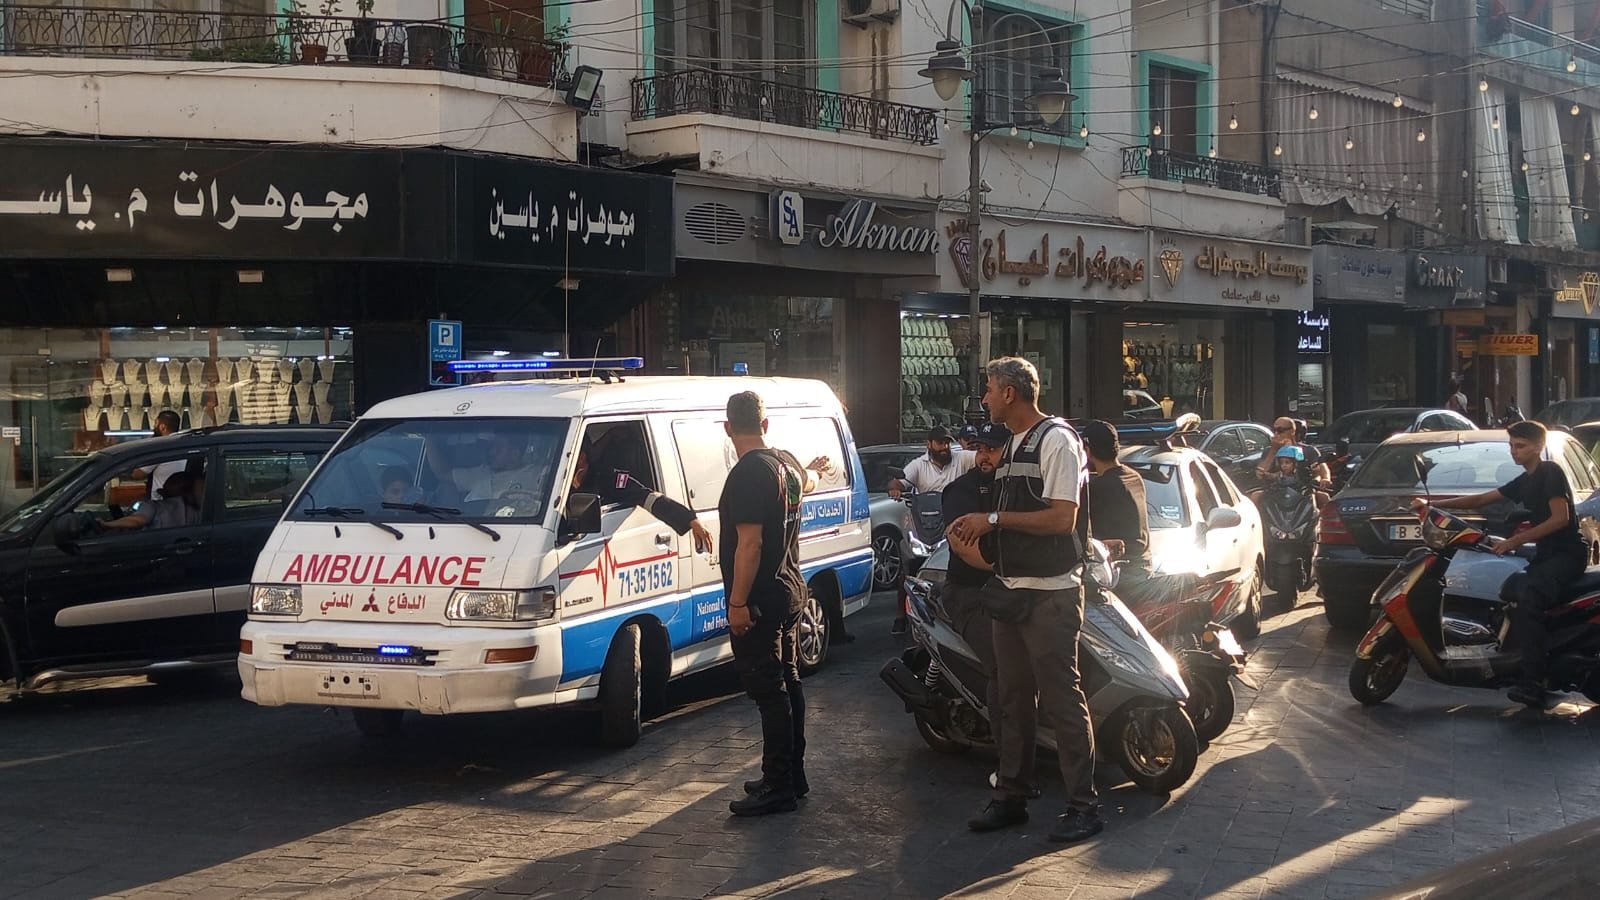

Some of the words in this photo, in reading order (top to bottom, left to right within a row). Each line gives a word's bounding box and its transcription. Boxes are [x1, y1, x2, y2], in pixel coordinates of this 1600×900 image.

[0, 172, 96, 232] ياس
[173, 170, 369, 232] مجوهرات
[489, 187, 539, 243] ياسين
[566, 189, 635, 249] مجوهرات
[820, 198, 938, 253] Aknan
[441, 327, 450, 343] P
[1399, 526, 1407, 538] B
[282, 554, 487, 587] AMBULANCE
[320, 593, 354, 616] المدني
[387, 594, 427, 614] الدفاع
[696, 597, 720, 617] National
[702, 616, 715, 633] And
